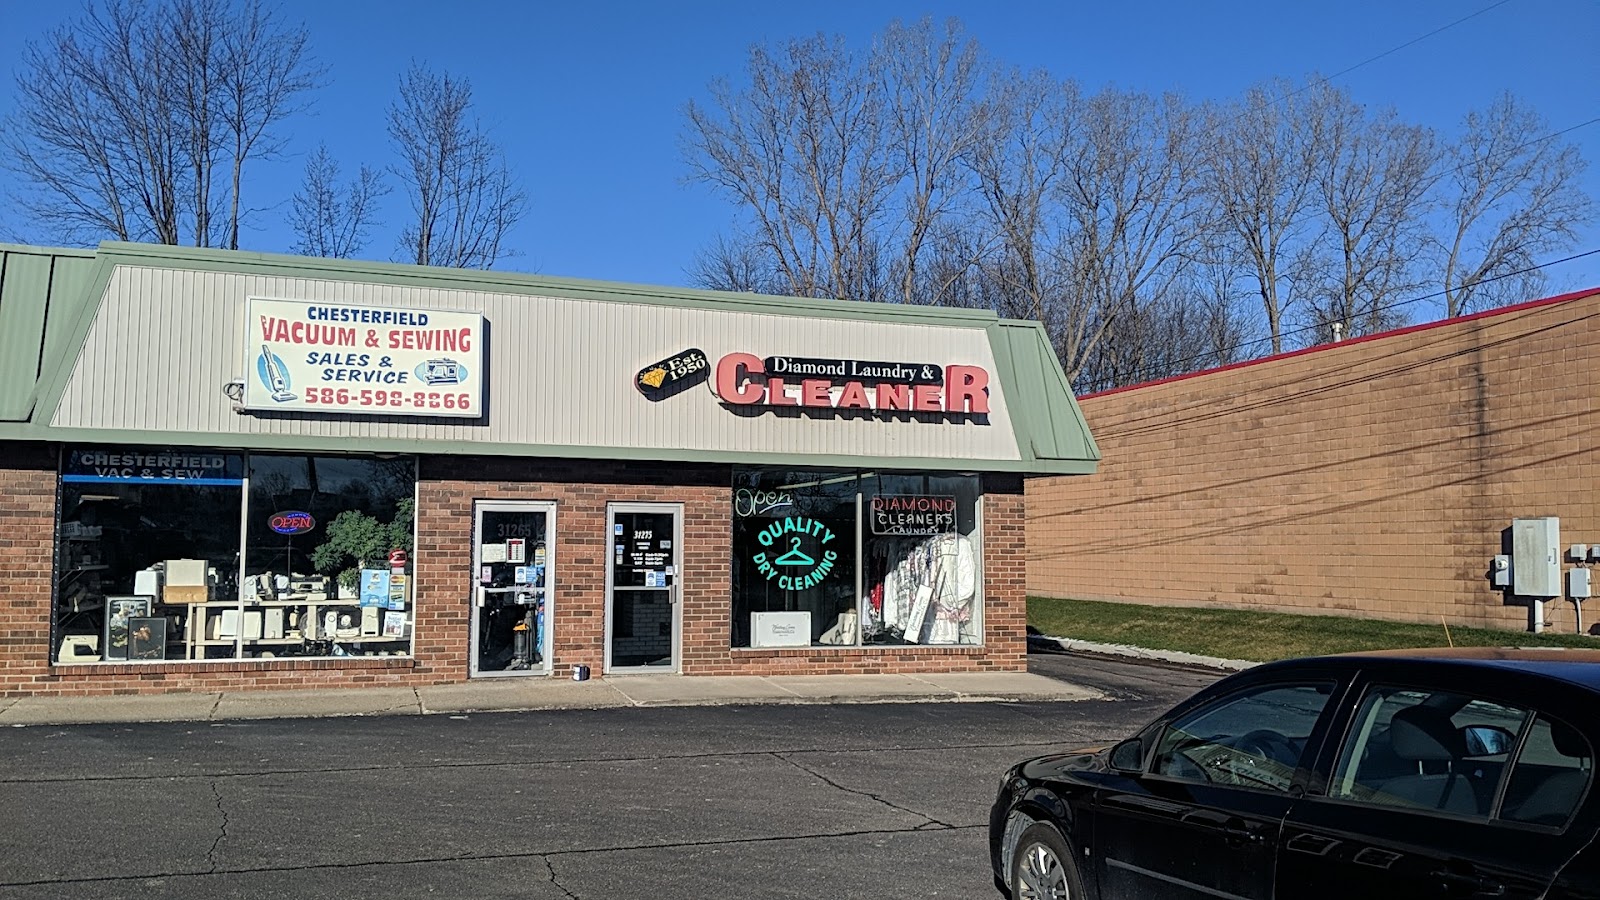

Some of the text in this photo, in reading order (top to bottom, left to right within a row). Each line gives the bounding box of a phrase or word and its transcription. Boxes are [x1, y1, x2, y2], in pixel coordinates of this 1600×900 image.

[308, 306, 428, 326] CHESTERFIELD
[260, 315, 471, 352] VACUUM & SEWING
[306, 352, 393, 368] SALES &
[668, 353, 702, 371] Est.
[321, 368, 409, 384] SERVICE
[670, 359, 706, 380] 1950
[773, 357, 934, 381] Diamond Laundry &
[305, 387, 470, 409] 586-598-8866
[81, 454, 225, 469] CHESTERFIELD
[94, 467, 205, 480] VAC & SEW
[735, 488, 793, 517] Open
[872, 497, 955, 512] DIAMOND
[271, 516, 311, 528] OPEN
[878, 513, 953, 525] CLEANERS
[497, 523, 532, 537] 31265
[633, 530, 653, 539] 31275
[758, 516, 836, 546] QUALITY
[753, 550, 838, 591] DRY CLEANING
